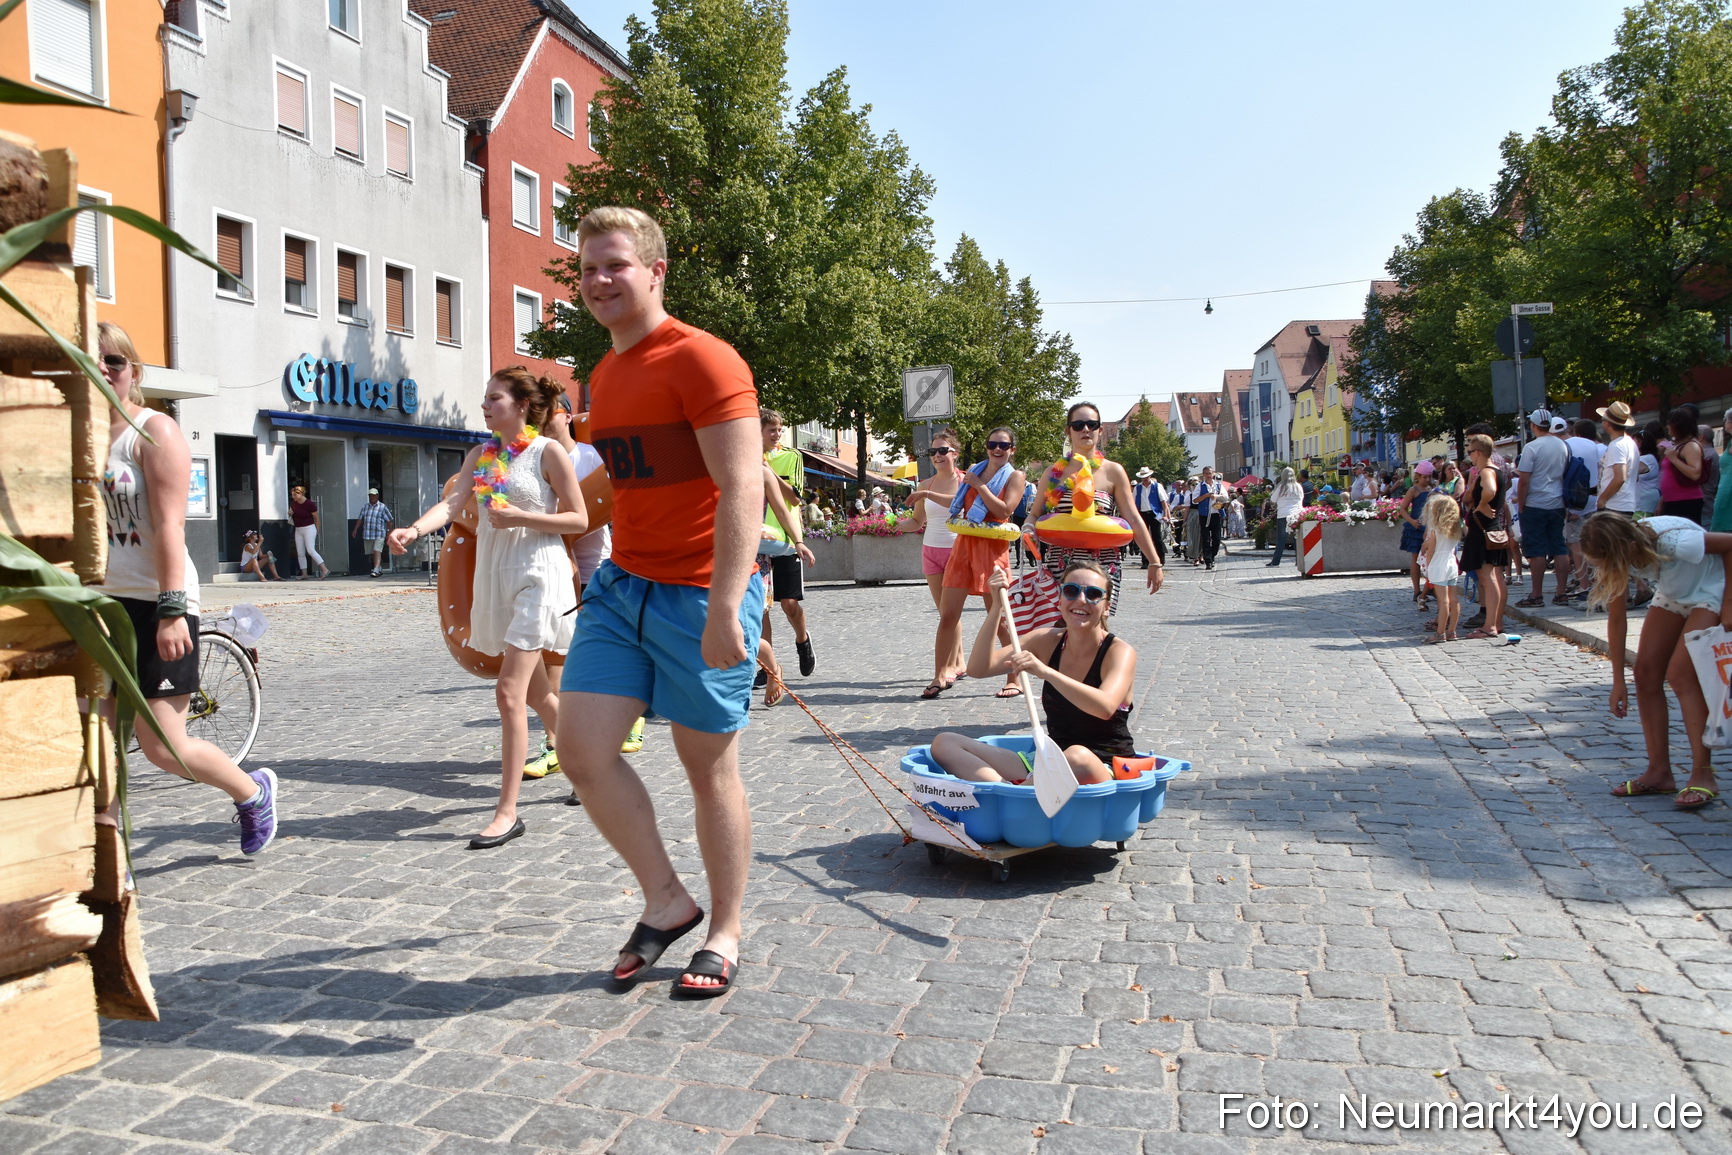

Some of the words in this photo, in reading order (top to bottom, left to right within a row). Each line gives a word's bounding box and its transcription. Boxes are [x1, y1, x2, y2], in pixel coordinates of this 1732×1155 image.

[1518, 305, 1534, 313] Ulmer
[1535, 304, 1550, 312] Gasse
[192, 431, 200, 440] 31
[913, 782, 946, 797] oßfahrt
